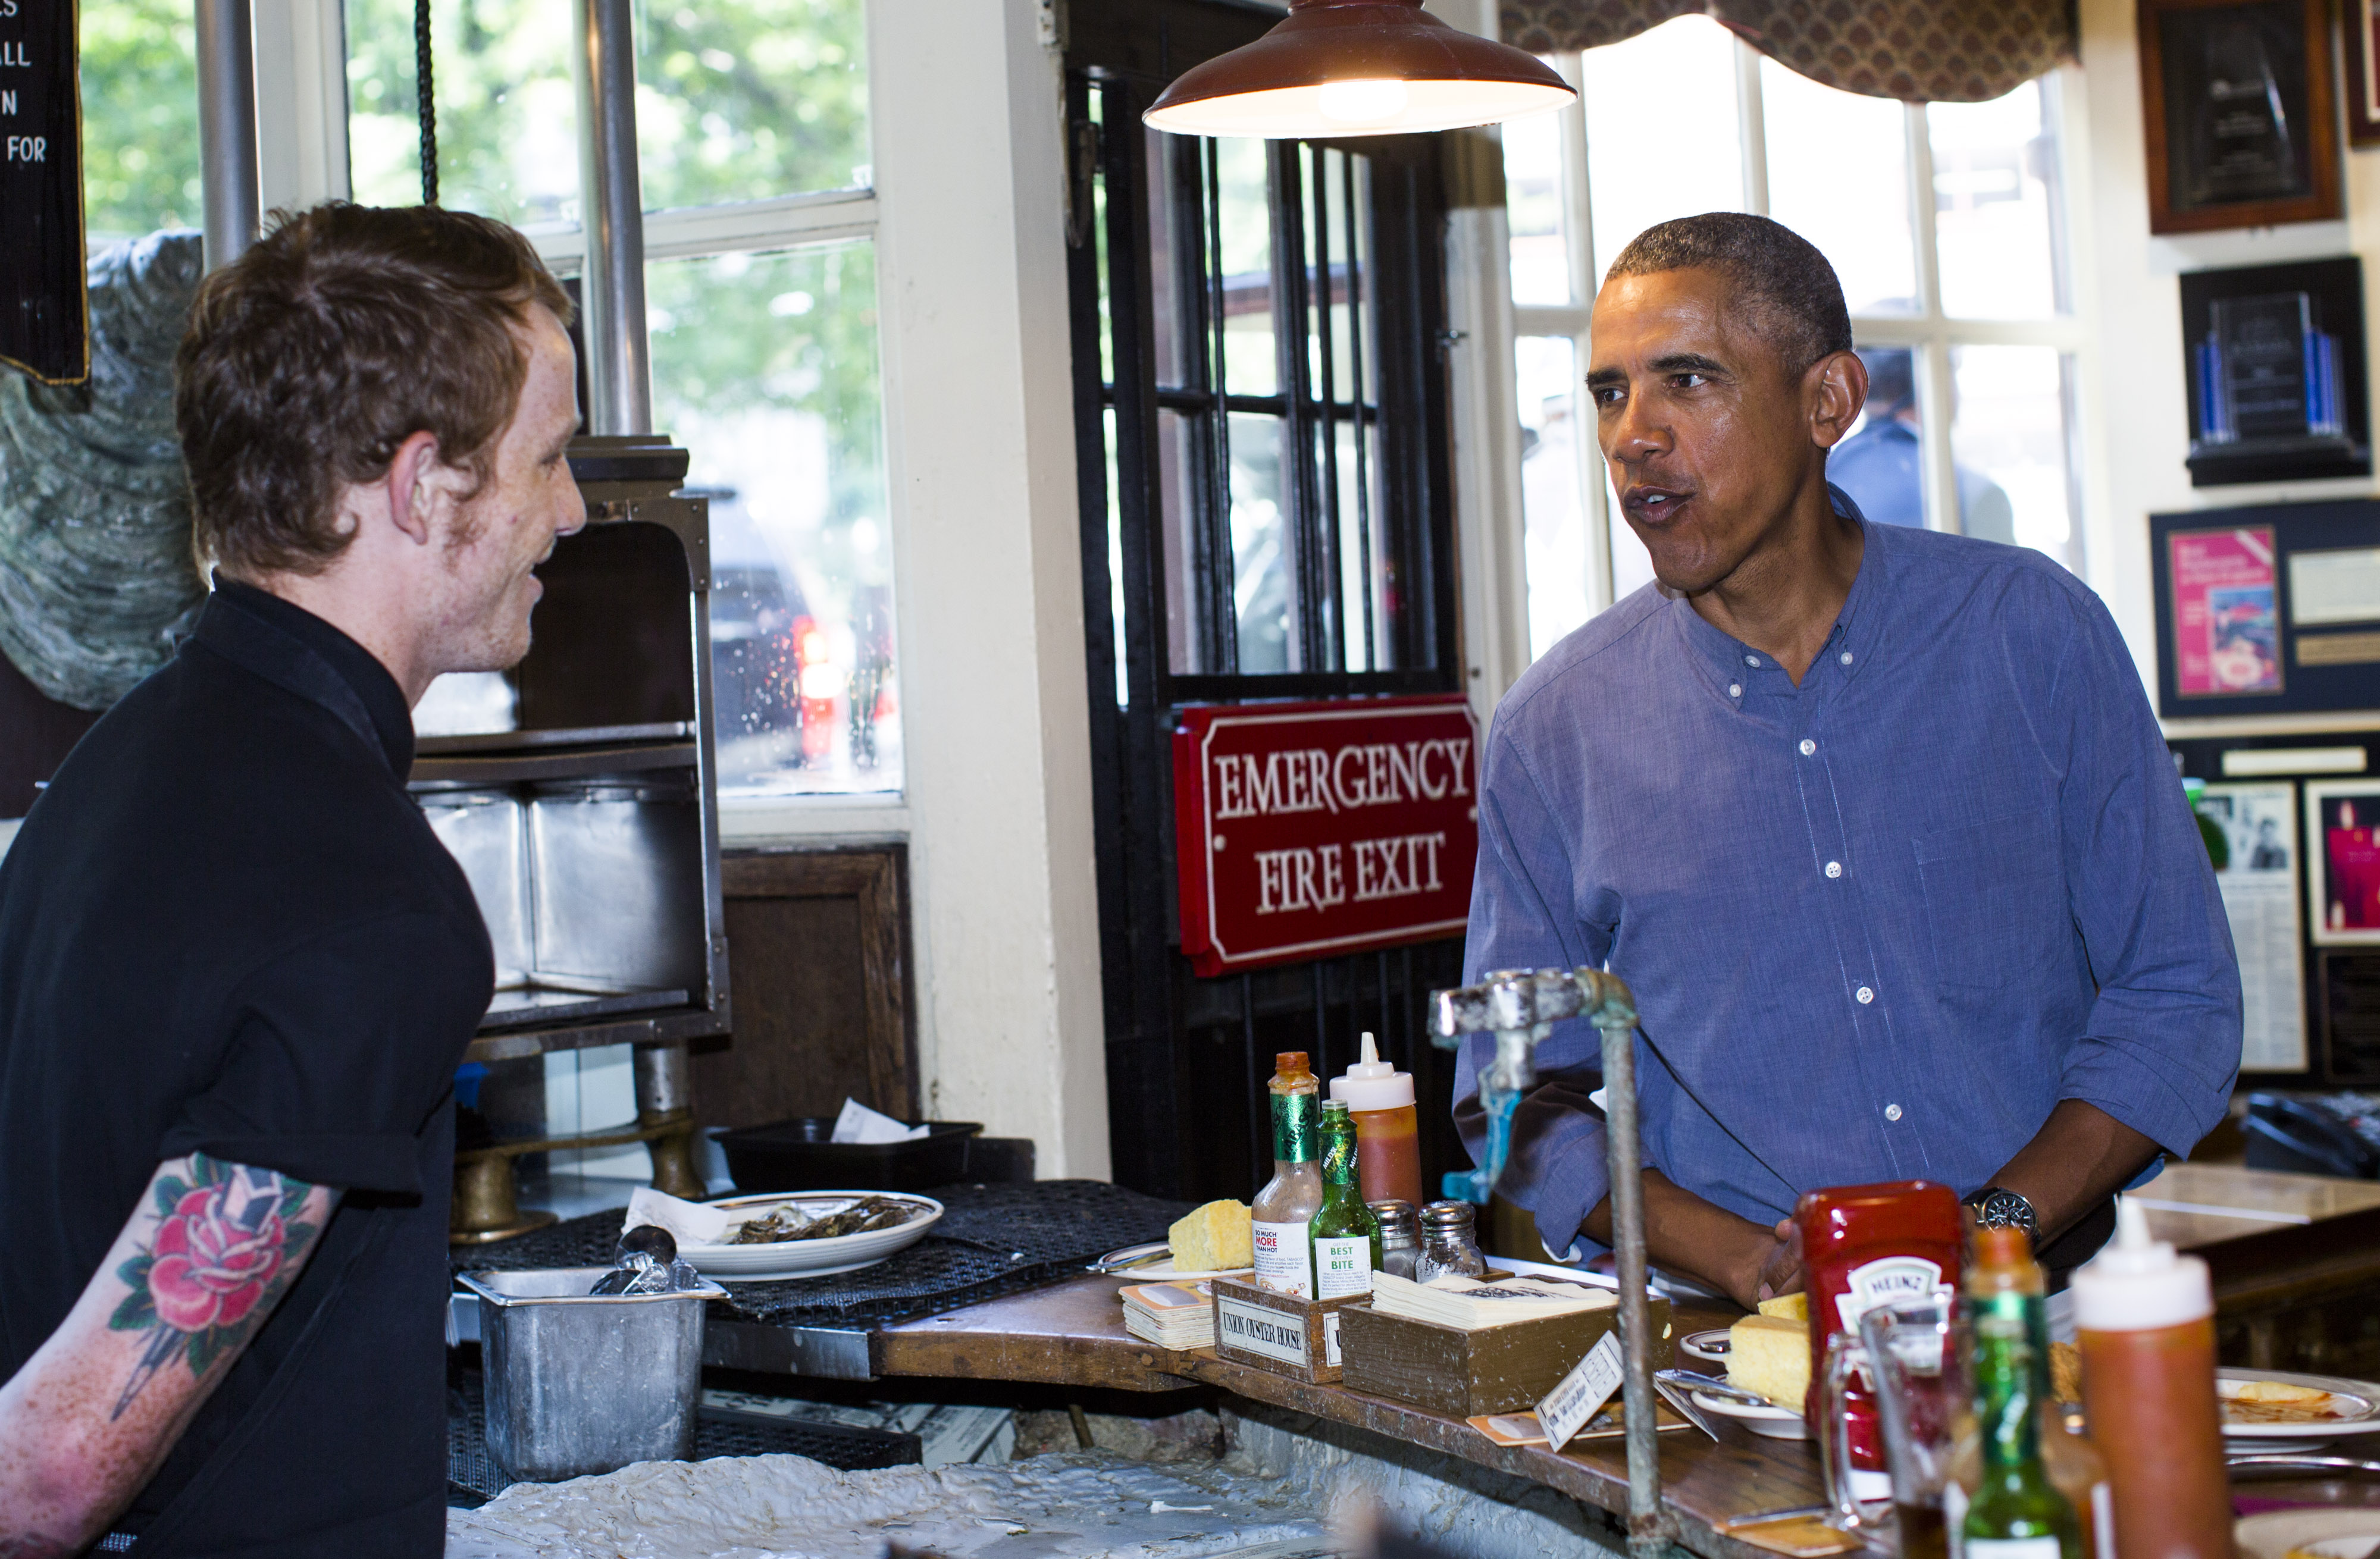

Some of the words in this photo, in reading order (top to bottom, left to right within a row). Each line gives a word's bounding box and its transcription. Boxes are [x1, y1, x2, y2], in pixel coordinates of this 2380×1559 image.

[7, 135, 47, 162] FOR
[1213, 737, 1470, 820] EMERGENCY
[1254, 843, 1346, 915] FIRE
[1351, 832, 1446, 902] EXIT
[1255, 1236, 1277, 1247] MORE
[1330, 1247, 1353, 1255] BEST
[1332, 1260, 1353, 1269] BITE
[1871, 1276, 1922, 1293] HEINZ
[1223, 1312, 1244, 1334] UNION
[1246, 1318, 1276, 1344] OYSTER
[1276, 1326, 1302, 1350] HOUSE
